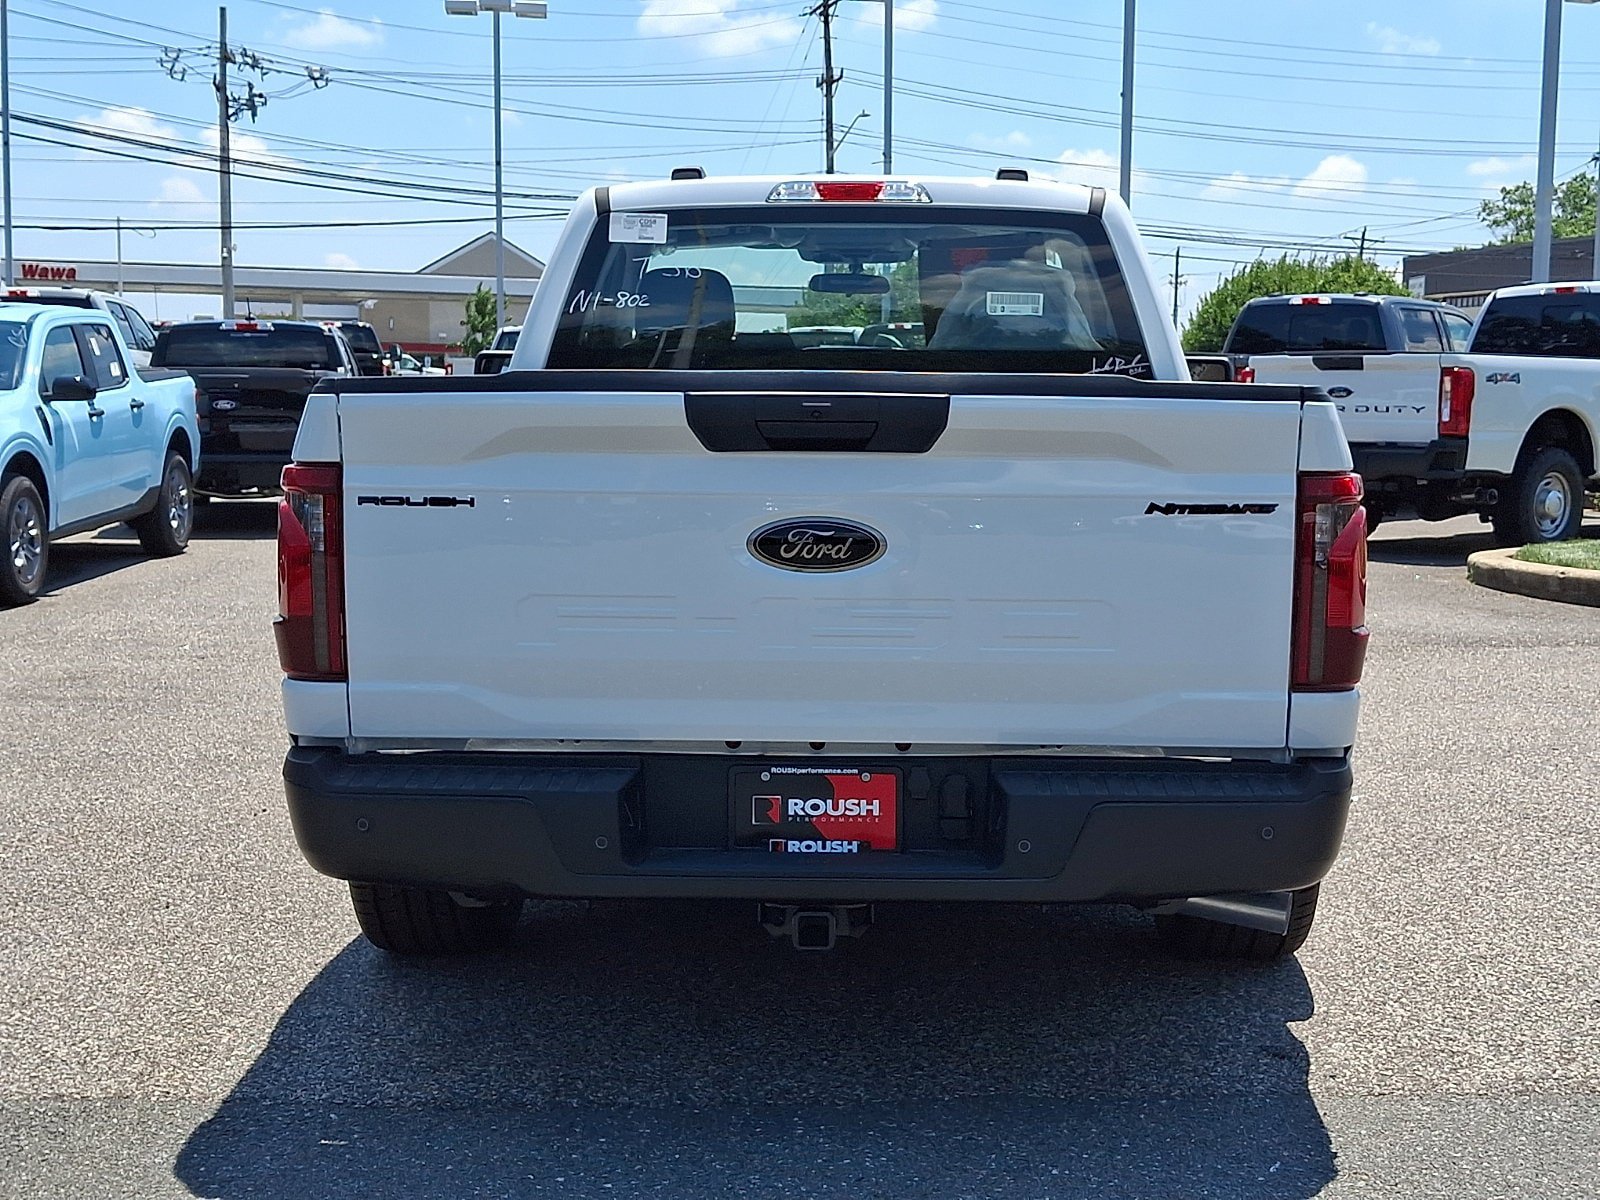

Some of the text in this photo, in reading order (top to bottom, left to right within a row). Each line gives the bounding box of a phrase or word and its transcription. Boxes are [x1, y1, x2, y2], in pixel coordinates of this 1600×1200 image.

[21, 264, 77, 281] Wawa
[1354, 405, 1426, 413] DUTY
[357, 496, 475, 507] ROUSH
[780, 528, 853, 559] Ford
[788, 799, 880, 816] ROUSH
[787, 840, 859, 853] ROUSH
